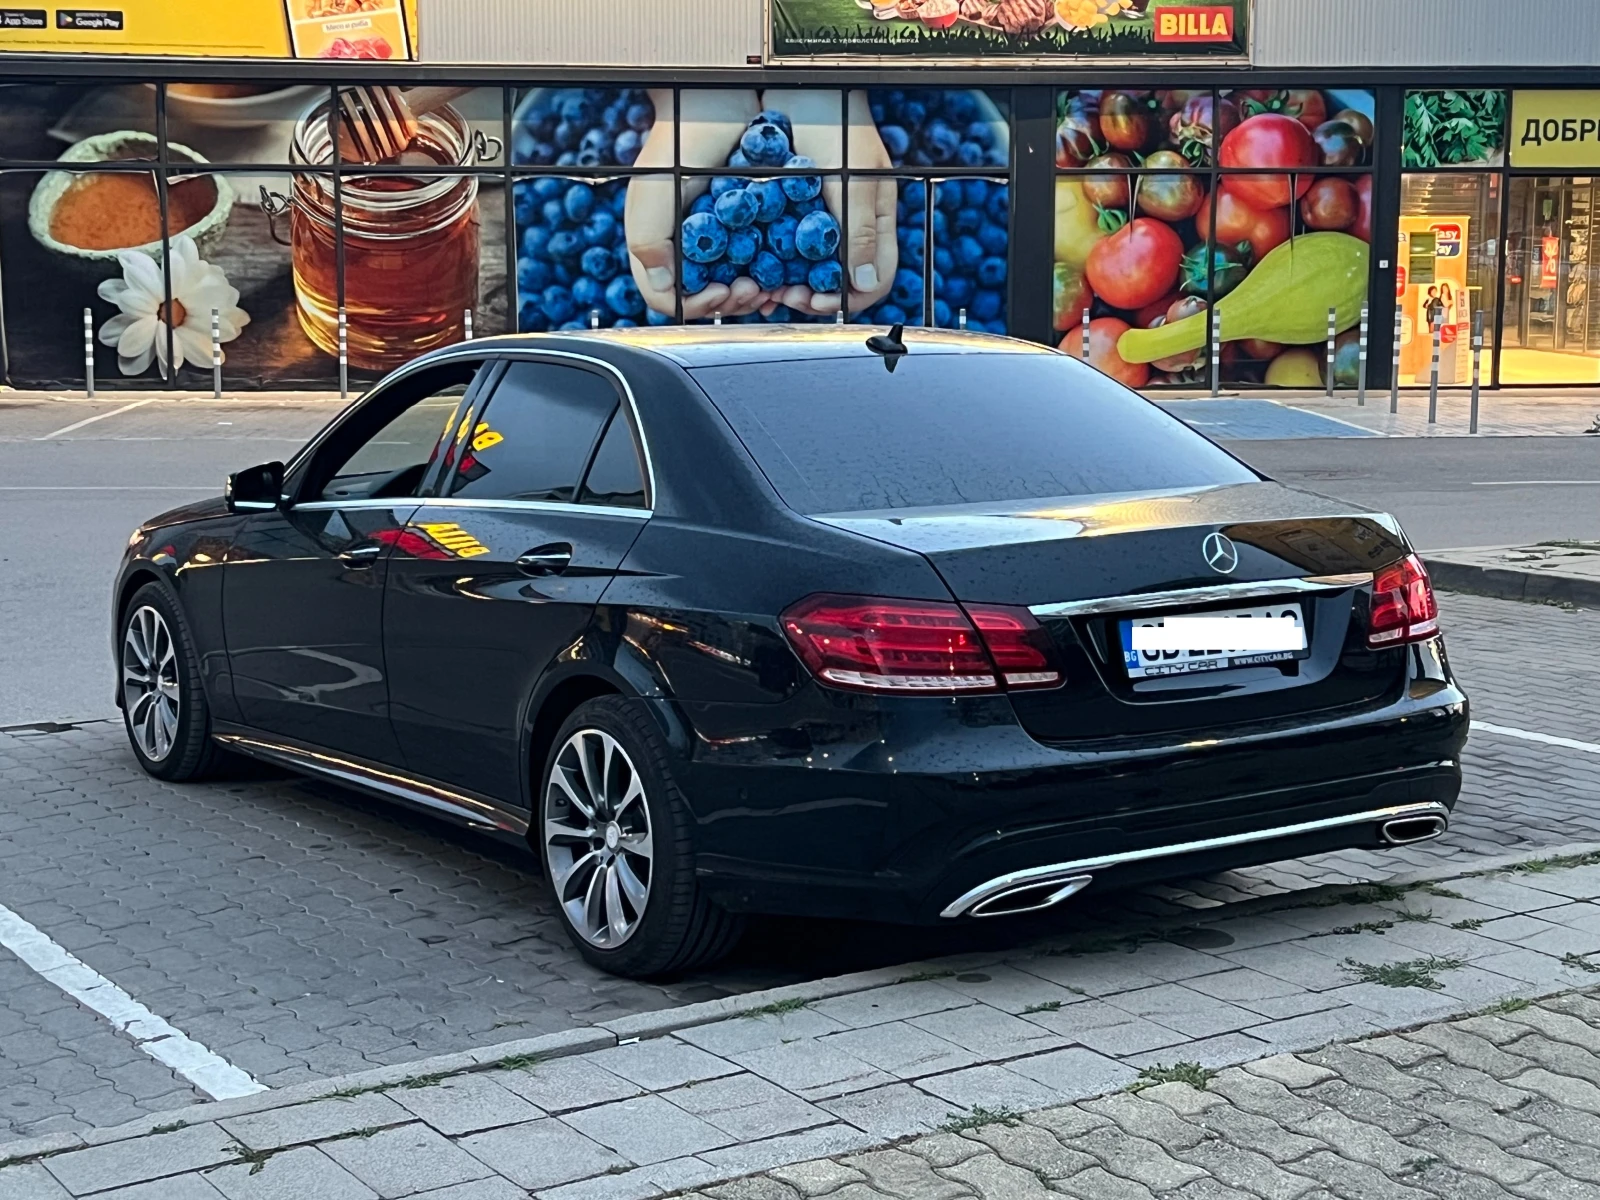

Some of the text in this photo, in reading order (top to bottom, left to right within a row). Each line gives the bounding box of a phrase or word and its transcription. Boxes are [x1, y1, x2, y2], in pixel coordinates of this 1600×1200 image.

[4, 17, 43, 26] App Store
[75, 18, 120, 28] Google Play
[1160, 13, 1228, 36] BILLA
[1521, 118, 1600, 146] ДОБР
[1432, 228, 1457, 240] asy
[1433, 243, 1452, 255] ay
[1124, 651, 1138, 662] BG
[1233, 651, 1294, 666] WWW.CITYCAR.BG
[1144, 660, 1218, 677] CITY CAR
